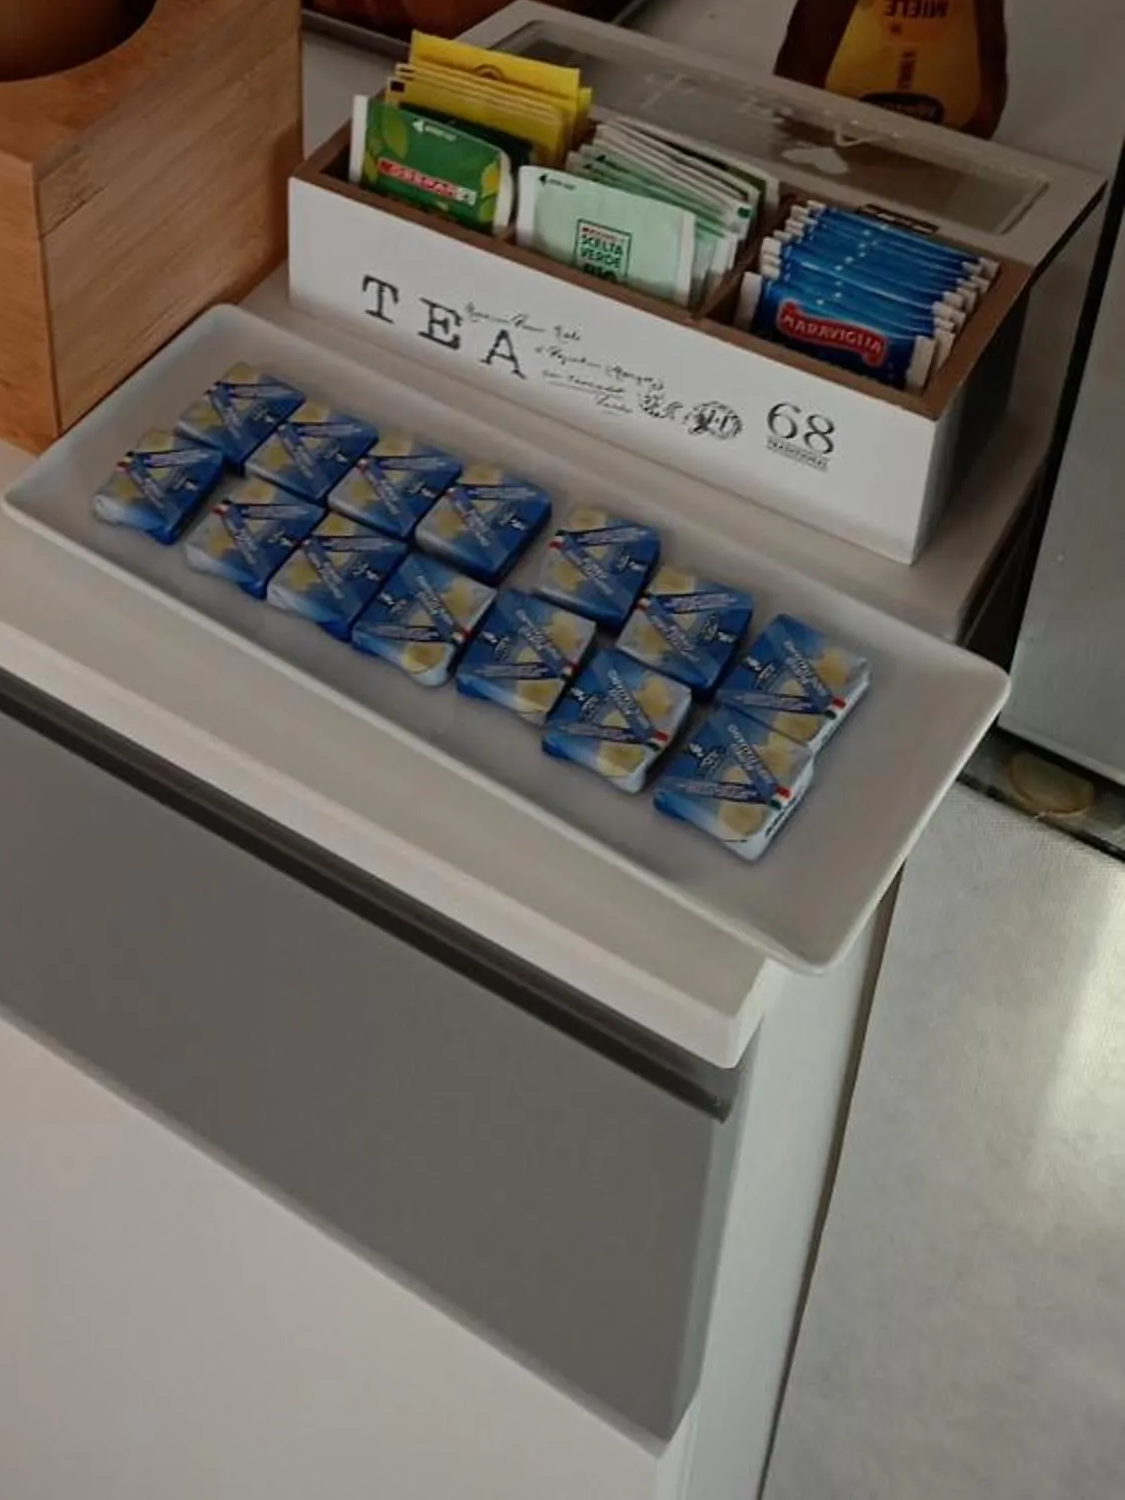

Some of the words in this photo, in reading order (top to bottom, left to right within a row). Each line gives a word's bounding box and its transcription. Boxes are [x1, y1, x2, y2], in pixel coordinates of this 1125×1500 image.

[581, 234, 624, 256] SCELTA
[581, 246, 621, 268] VERDE
[362, 274, 527, 380] TEA
[781, 313, 883, 353] MARAVIGLIA
[766, 402, 836, 456] 68
